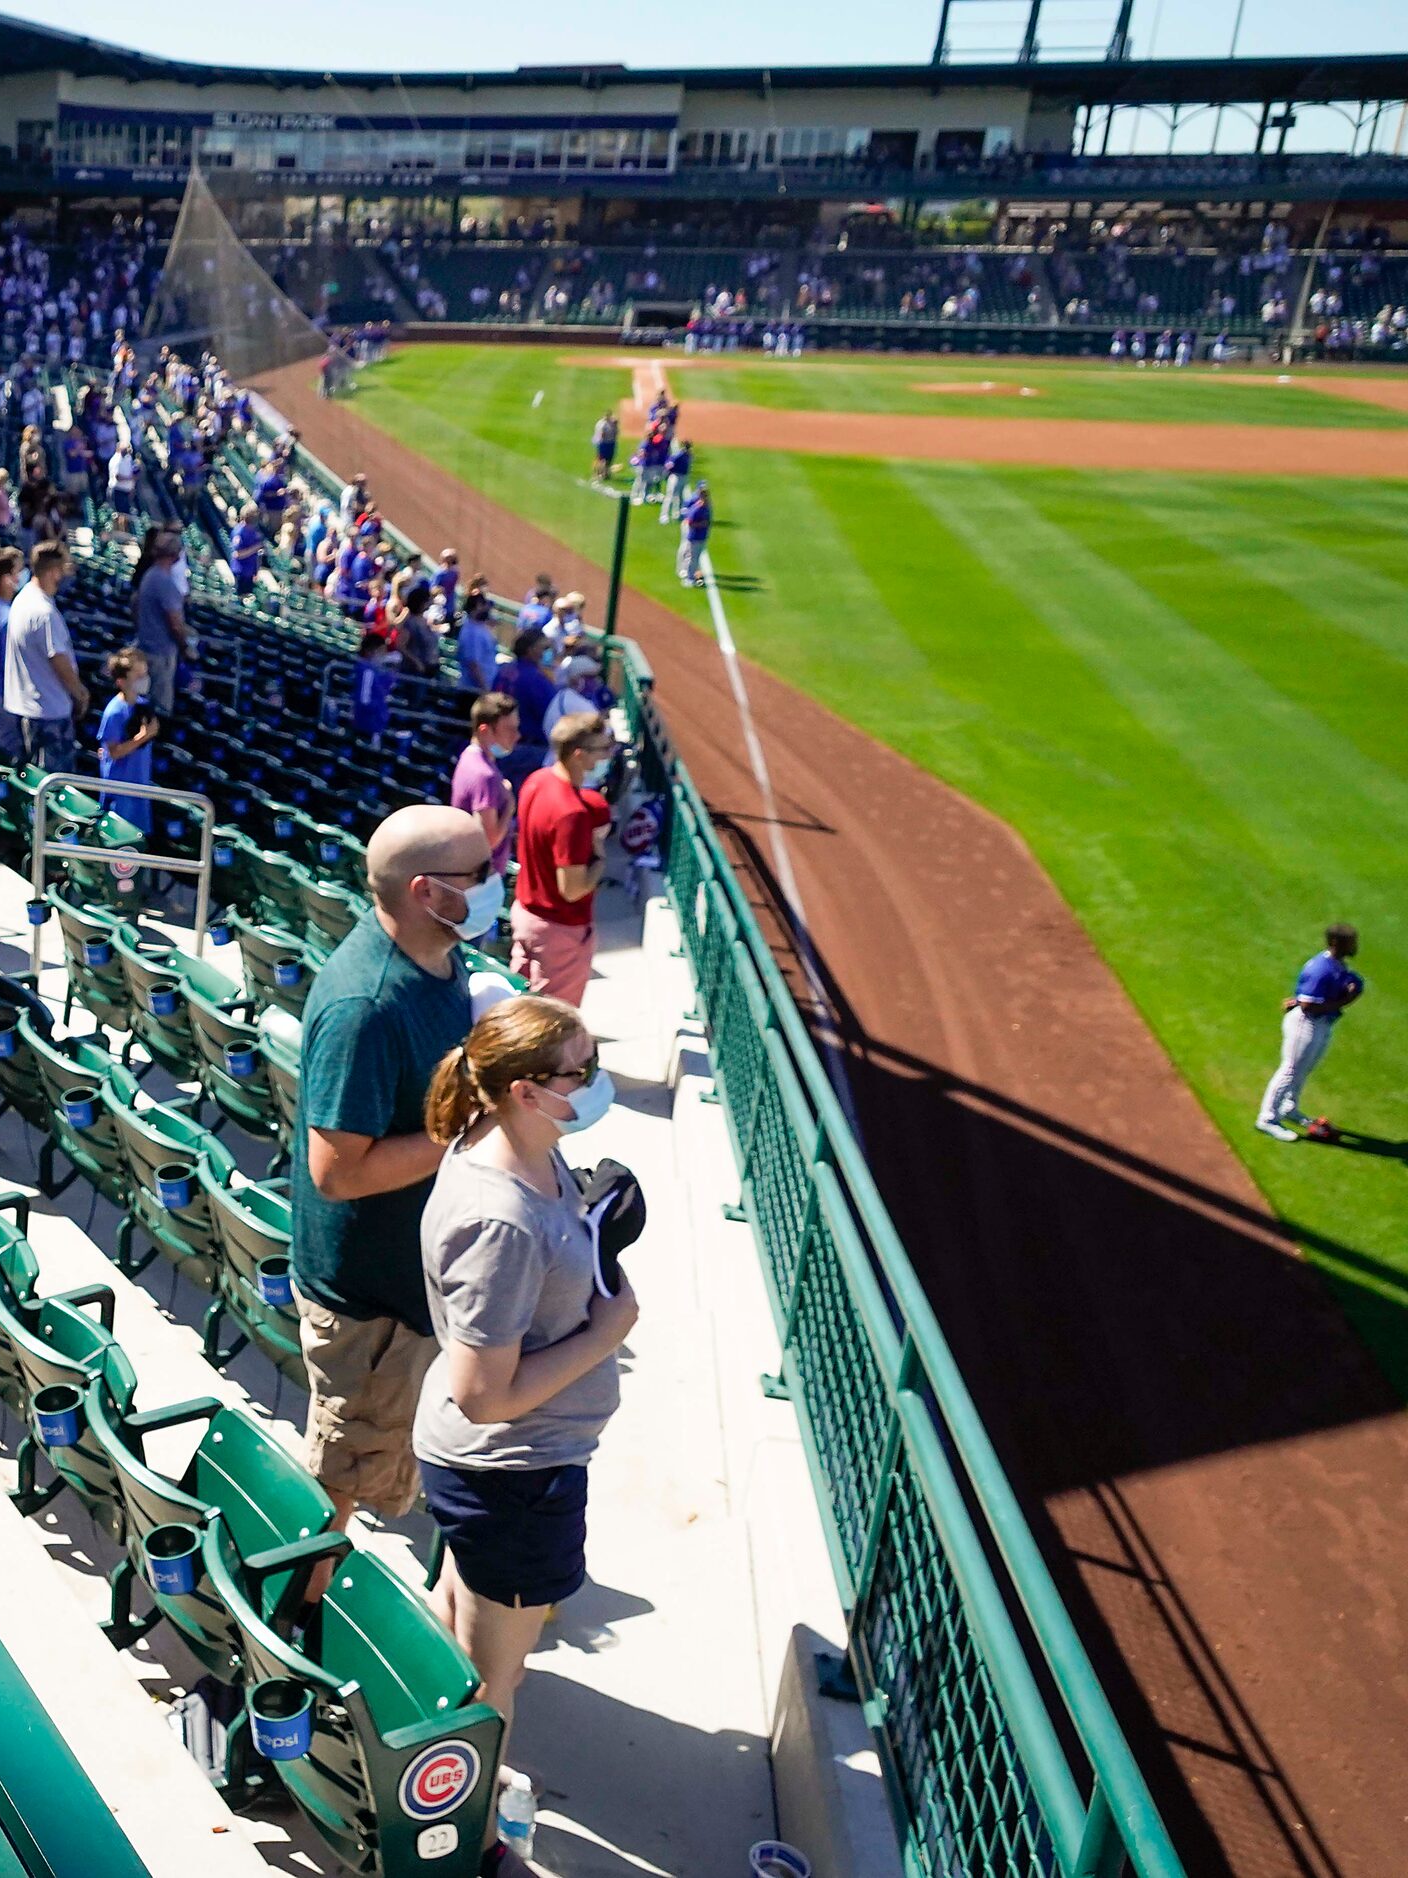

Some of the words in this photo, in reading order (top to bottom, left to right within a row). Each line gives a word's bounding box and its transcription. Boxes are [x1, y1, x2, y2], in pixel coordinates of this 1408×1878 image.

[257, 1728, 299, 1750] epsi
[417, 1757, 465, 1804] CUBS
[428, 1831, 449, 1854] 22
